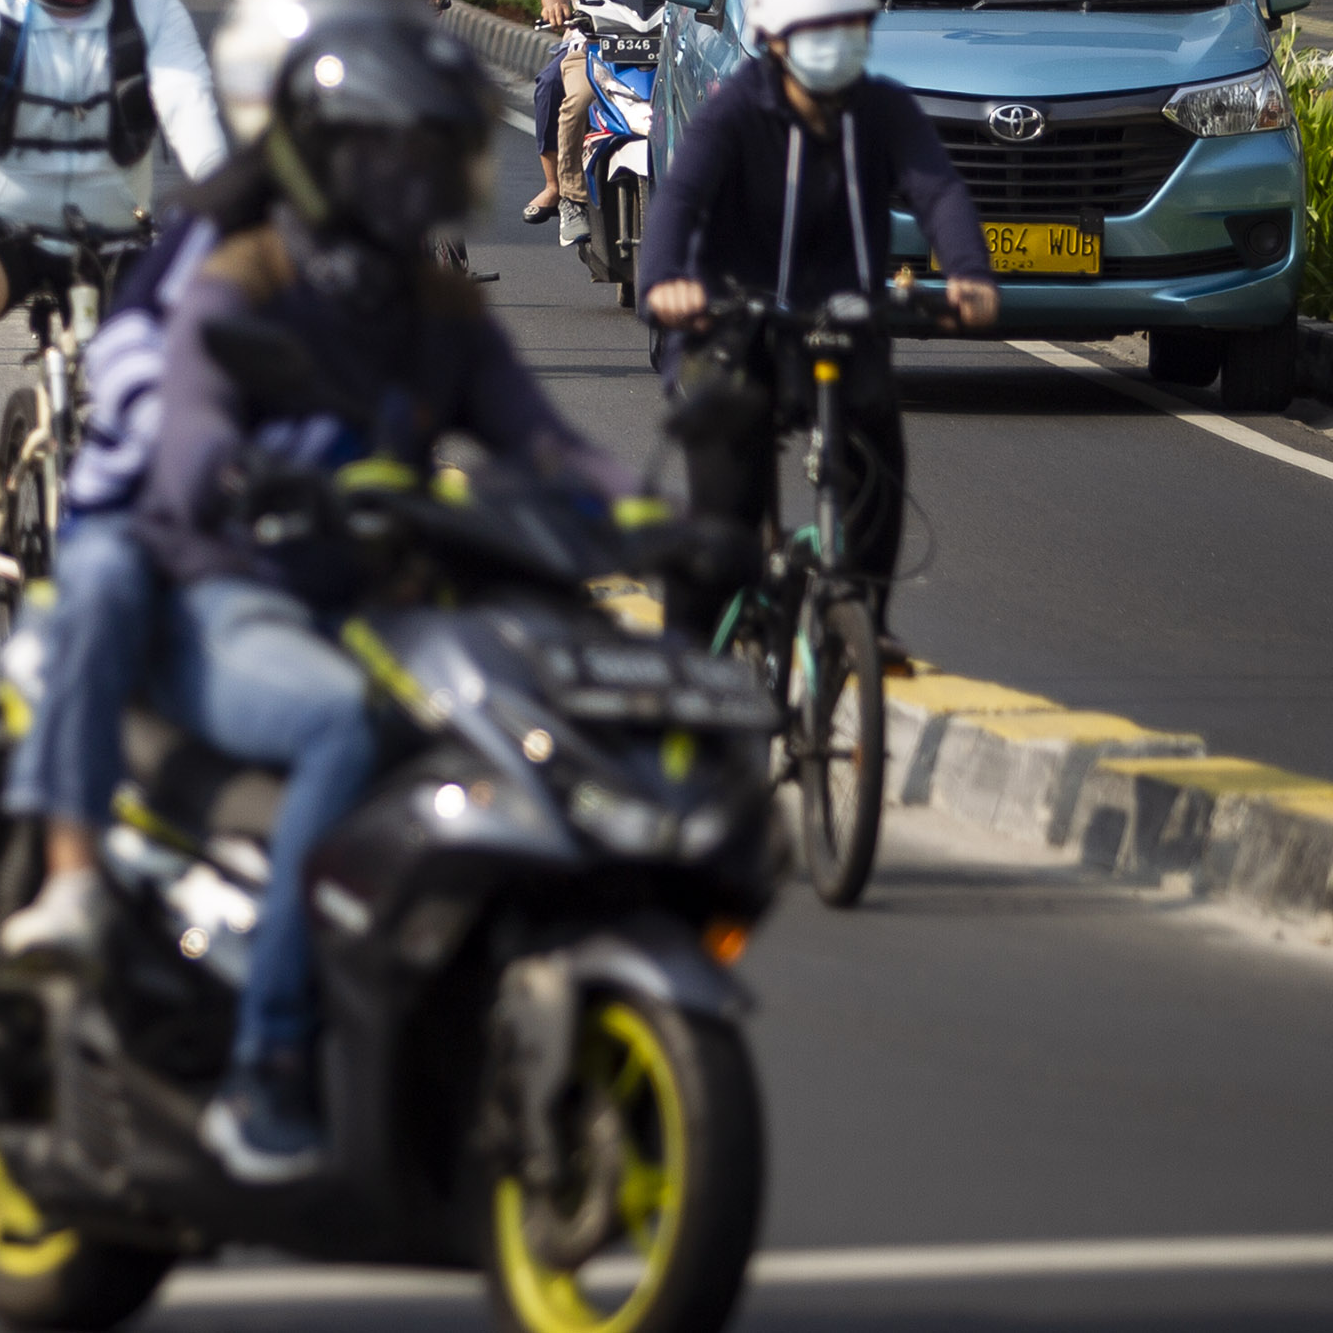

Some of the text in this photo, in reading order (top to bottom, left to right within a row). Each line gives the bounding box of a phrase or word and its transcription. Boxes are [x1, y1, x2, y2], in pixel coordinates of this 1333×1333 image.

[602, 39, 651, 51] B 6346
[1049, 227, 1094, 257] WUB
